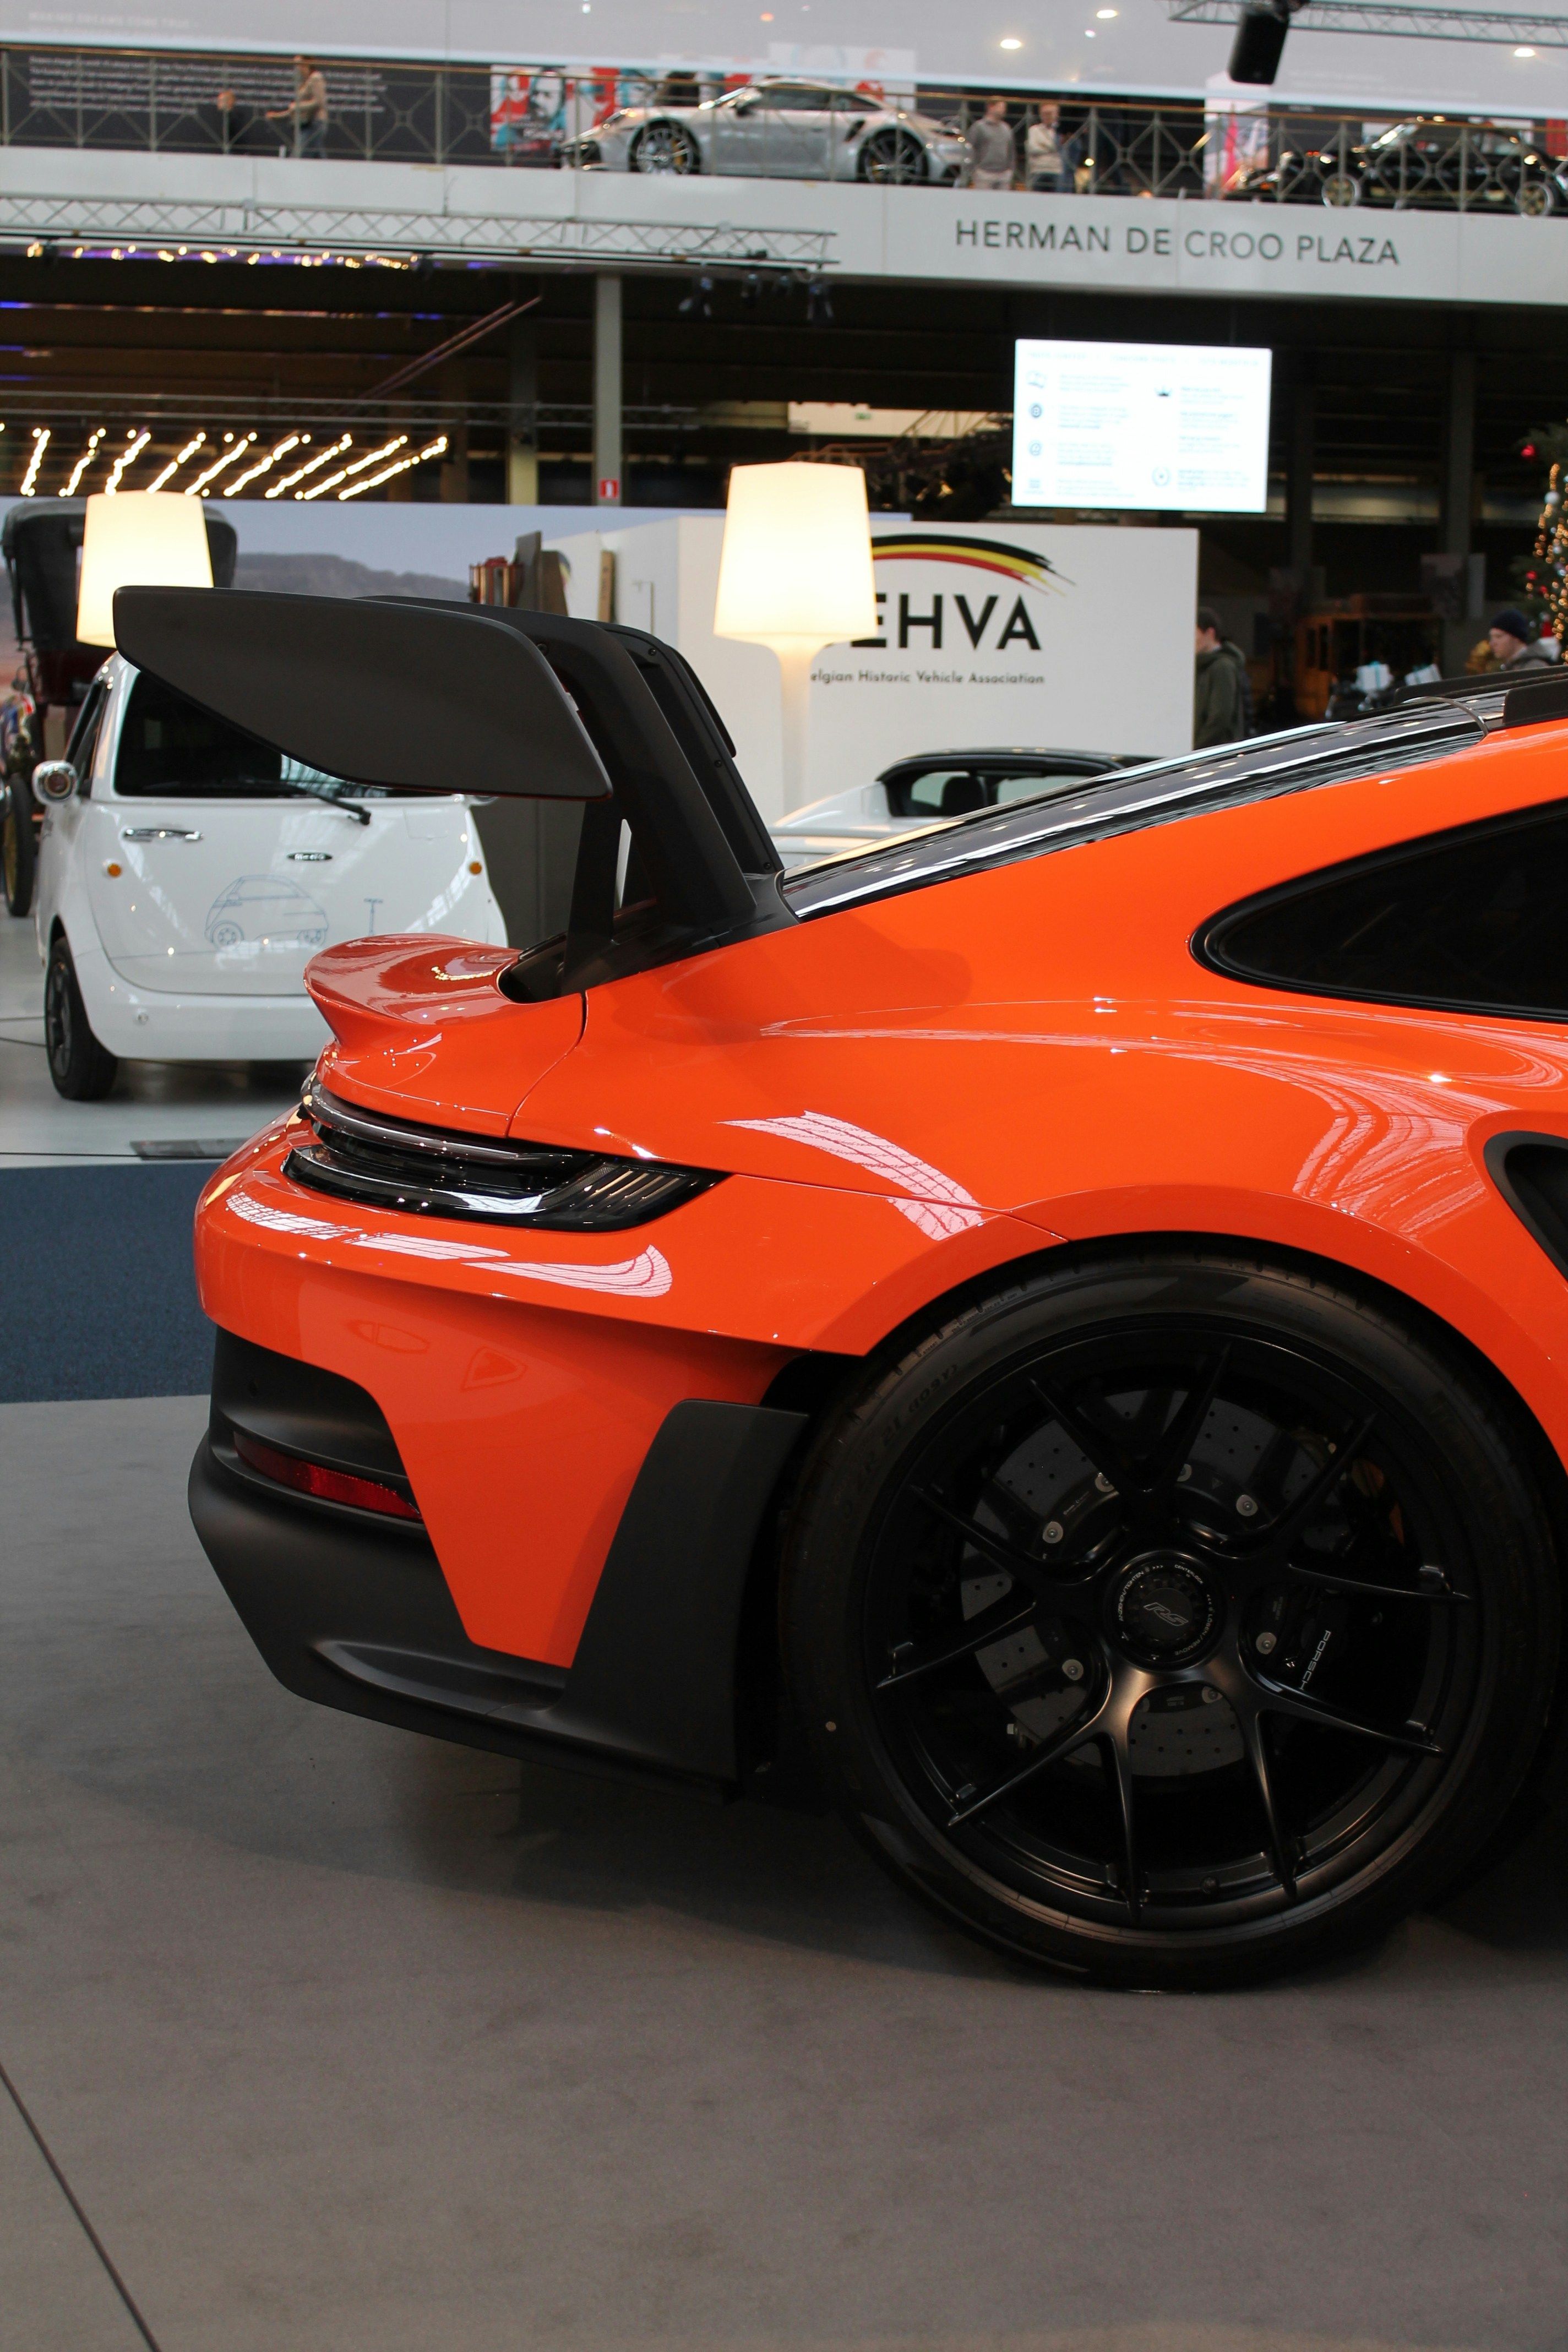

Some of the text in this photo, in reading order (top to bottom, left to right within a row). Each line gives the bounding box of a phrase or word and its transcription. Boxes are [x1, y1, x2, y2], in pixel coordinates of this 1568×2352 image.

[956, 220, 1400, 266] HERMAN DE CROO PLAZA
[850, 592, 1042, 650] EHVA
[810, 669, 1044, 684] elgian Historic Vehicle Association
[1174, 1564, 1204, 1585] CENTERLOCK
[1143, 1602, 1189, 1626] RS
[1299, 1630, 1331, 1691] PORSCH
